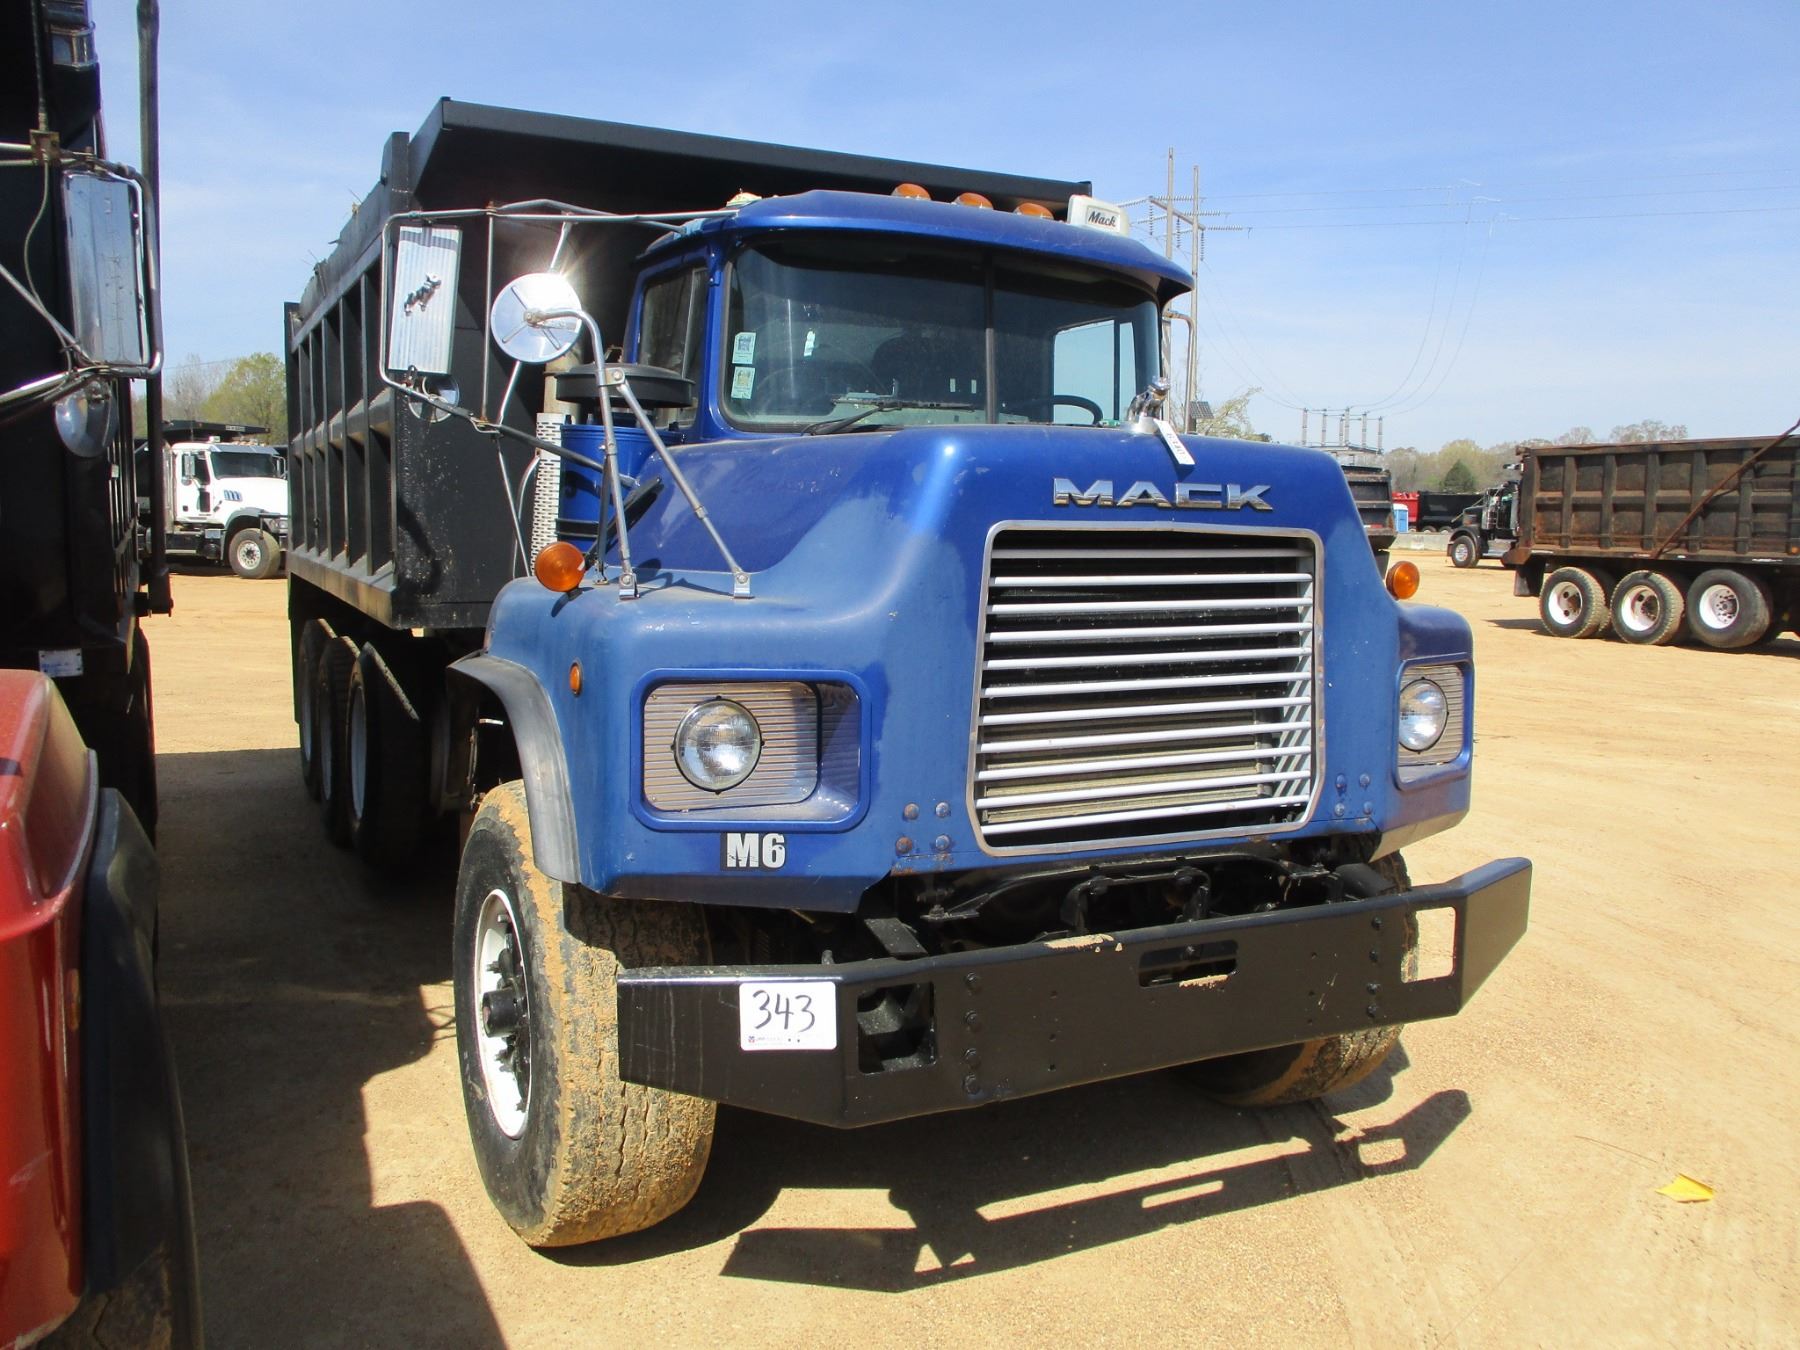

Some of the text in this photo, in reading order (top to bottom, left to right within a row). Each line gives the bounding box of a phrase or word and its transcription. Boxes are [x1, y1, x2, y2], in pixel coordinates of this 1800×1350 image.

[1088, 210, 1116, 227] Mack
[1053, 478, 1273, 510] MACK
[727, 832, 786, 868] M6
[752, 989, 816, 1033] 343
